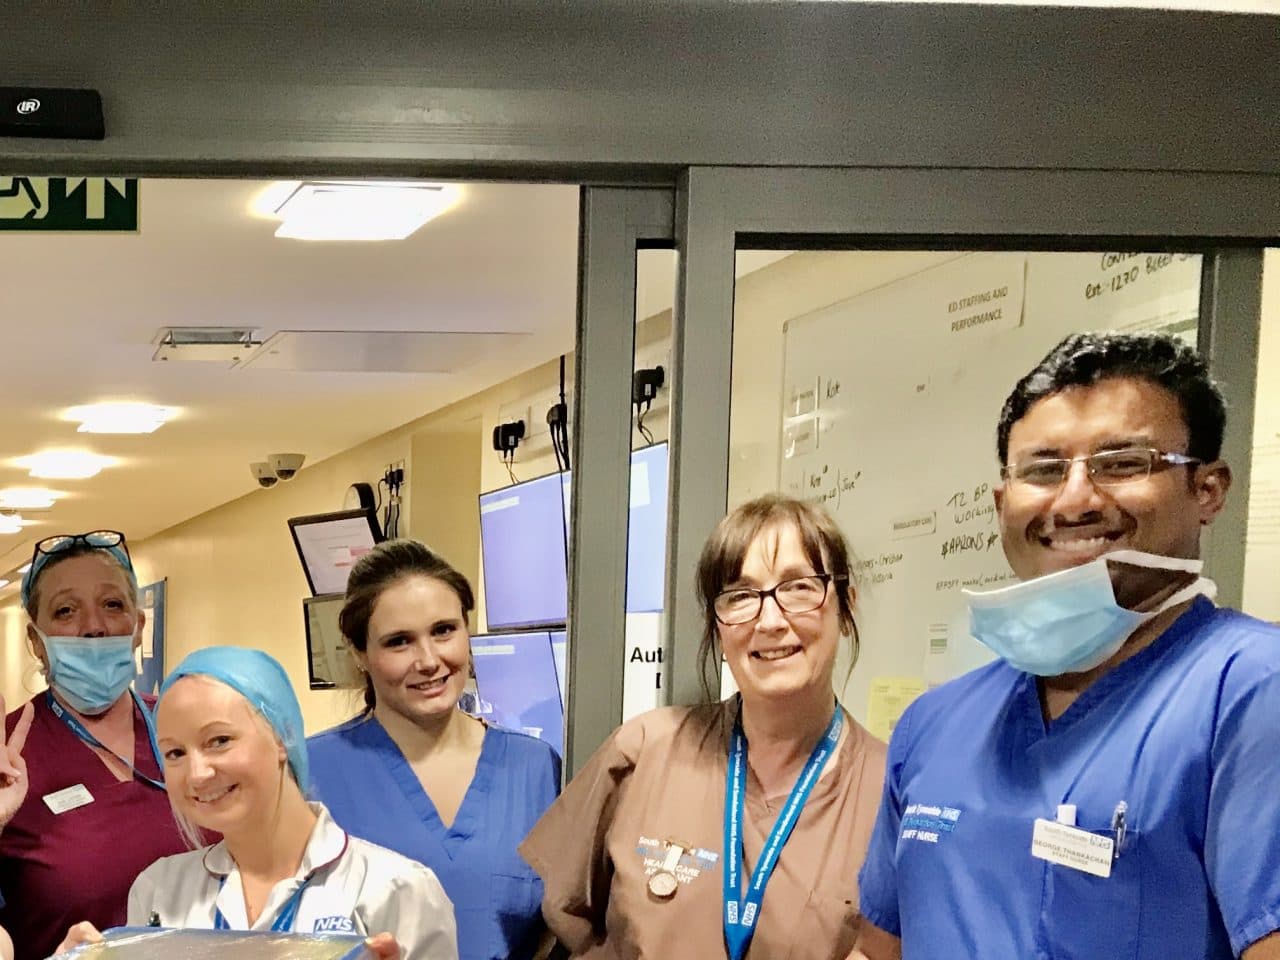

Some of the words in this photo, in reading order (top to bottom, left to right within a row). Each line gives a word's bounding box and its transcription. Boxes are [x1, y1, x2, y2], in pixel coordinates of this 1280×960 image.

[958, 292, 991, 311] STAFFING
[992, 286, 1008, 299] AND
[951, 308, 1003, 332] PERFORMANCE
[954, 505, 995, 524] working
[760, 847, 775, 872] Tyneside
[799, 763, 818, 793] Foundation
[917, 830, 939, 843] NURSE
[1034, 839, 1061, 851] GEORGE
[675, 864, 701, 878] CARE
[728, 901, 738, 923] NHS
[742, 902, 757, 926] NHS
[314, 917, 355, 933] NHS
